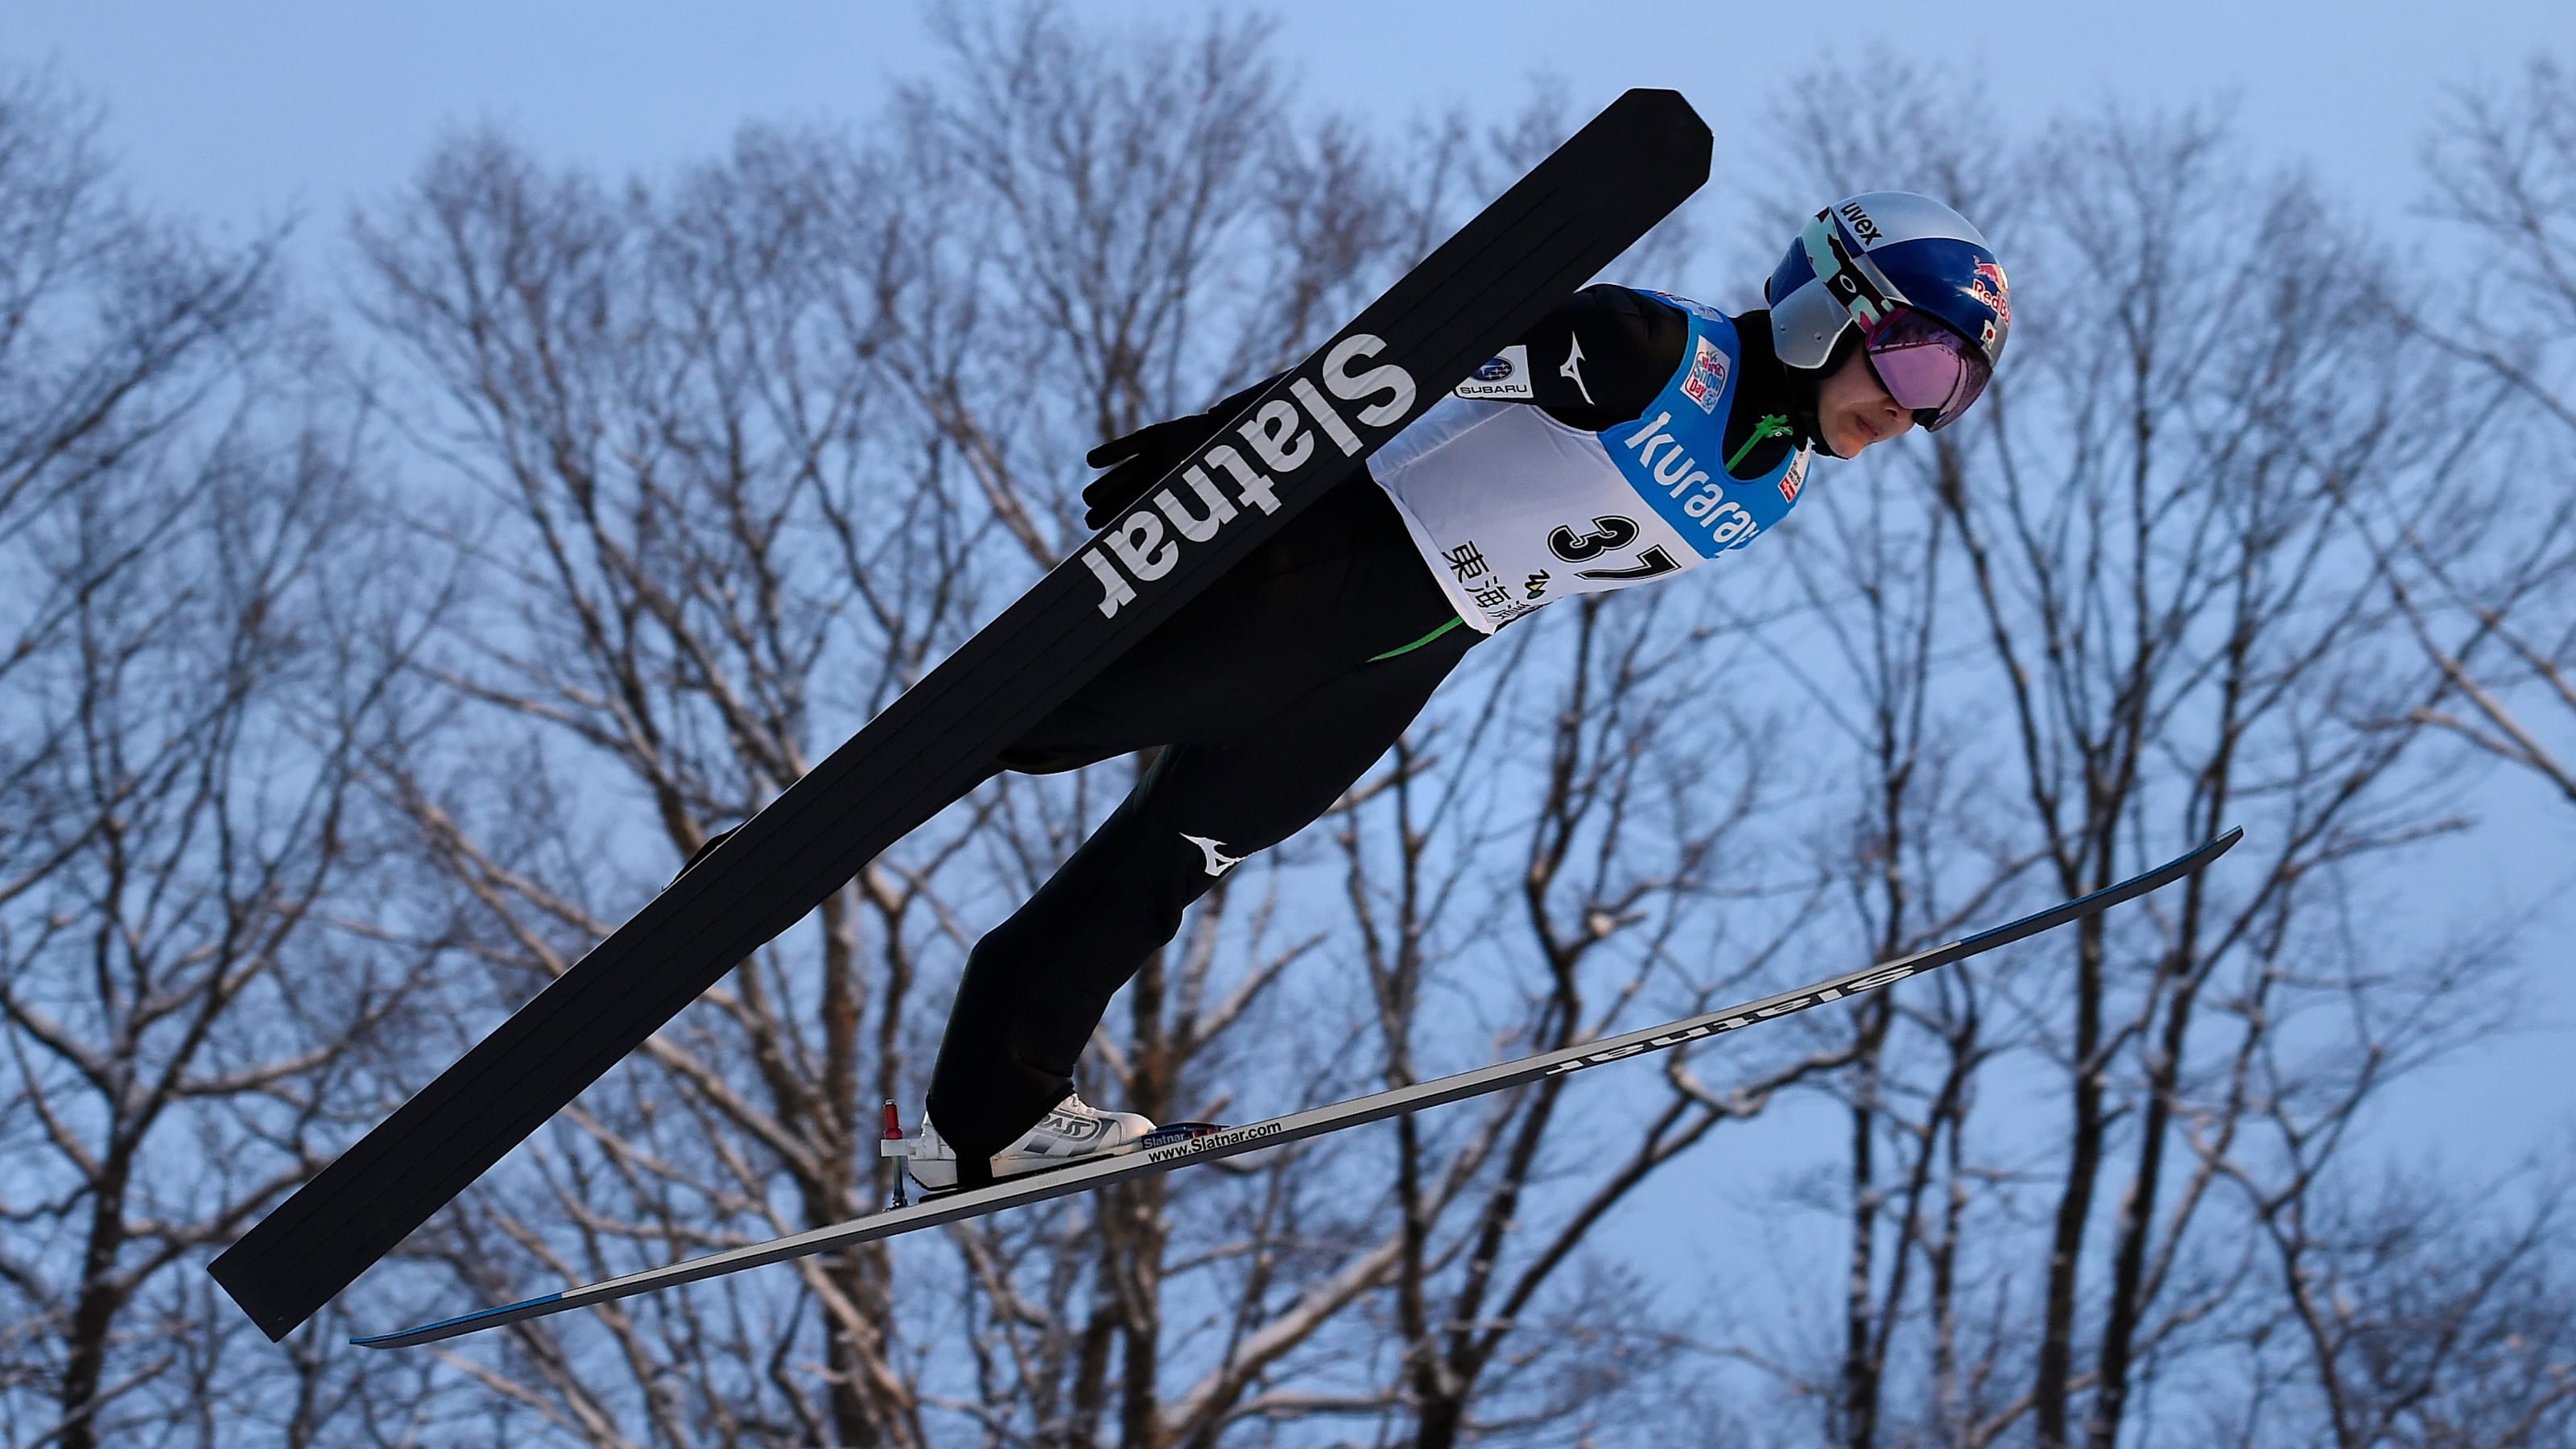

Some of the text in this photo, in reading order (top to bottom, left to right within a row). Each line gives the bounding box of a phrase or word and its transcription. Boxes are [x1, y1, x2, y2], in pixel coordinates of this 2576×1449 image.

[1840, 202, 1883, 246] uvex
[1972, 279, 2001, 313] Red
[1459, 384, 1528, 394] SUBARU
[1690, 378, 1707, 398] Day
[1081, 333, 1417, 619] Slatnar
[1546, 514, 1682, 580] 37
[1546, 965, 1913, 1075] Slatnar
[1143, 1133, 1186, 1149] Slatnar
[1148, 1122, 1282, 1162] www.Slatnar.com
